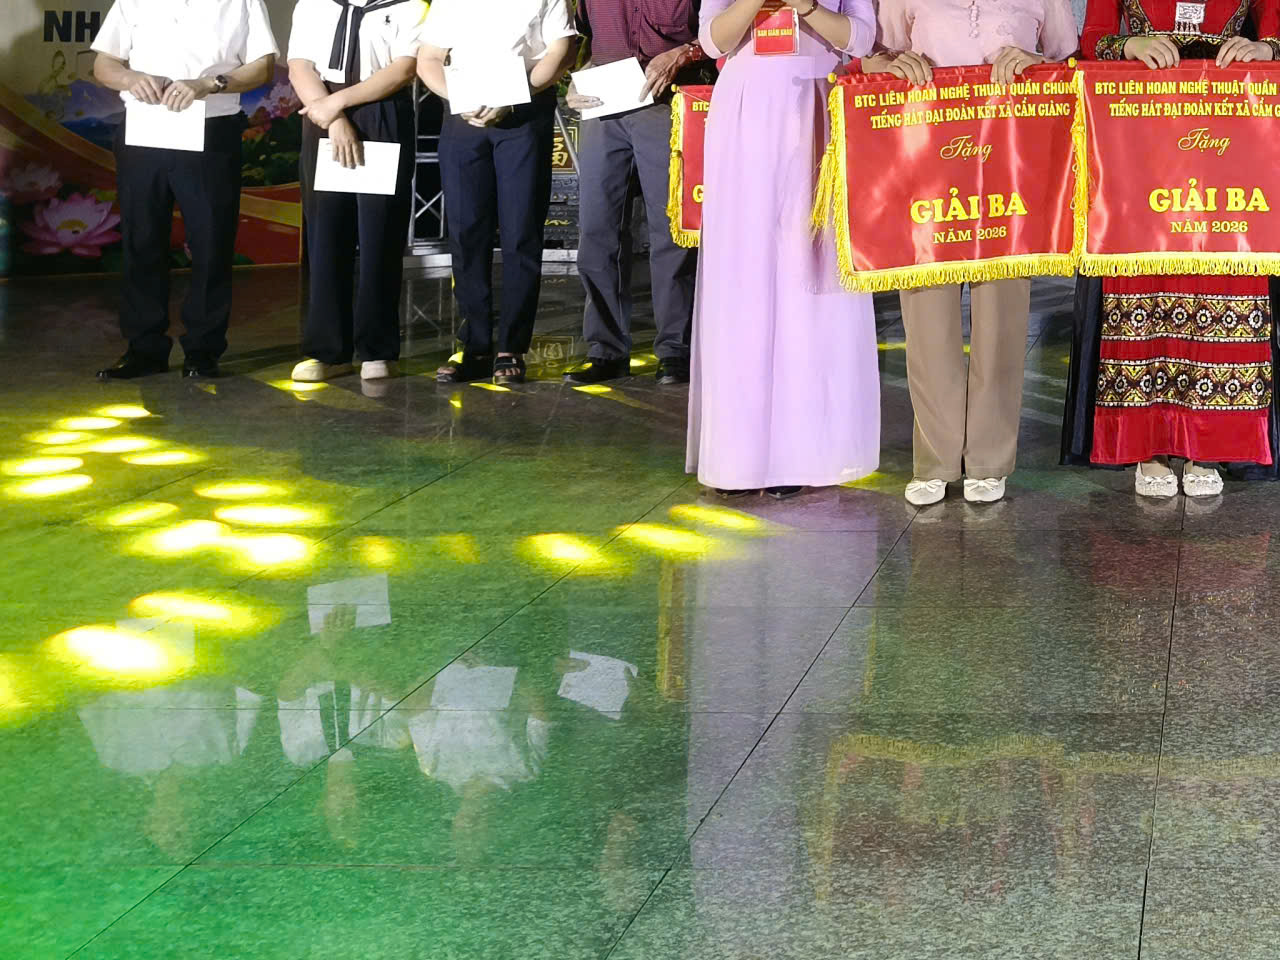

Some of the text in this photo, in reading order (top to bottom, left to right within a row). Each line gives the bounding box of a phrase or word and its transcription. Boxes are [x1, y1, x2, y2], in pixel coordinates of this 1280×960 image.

[44, 10, 101, 43] NH
[854, 95, 876, 108] BTC
[879, 90, 904, 107] LIÊN
[908, 88, 937, 104] HOAN
[940, 83, 970, 101] NGHỆ
[1010, 79, 1040, 96] QUẦN
[1043, 80, 1077, 95] CHÚN
[1095, 82, 1116, 95] BTC
[1119, 80, 1143, 95] LIÊN
[1147, 82, 1176, 95] HOAN
[1179, 79, 1208, 97] NGHỆ
[1212, 80, 1245, 97] THUẬT
[1248, 79, 1277, 96] QUẦN
[871, 97, 1070, 129] TIẾNG HÁT ĐẠI ĐOÀN KẾT XÃ CẨM GIÀNG
[1110, 98, 1139, 117] TIẾNG
[1142, 99, 1162, 117] HÁT
[1164, 103, 1182, 119] ĐẠI
[1184, 99, 1211, 116] ĐOÀN
[1214, 98, 1234, 116] KẾT
[1236, 100, 1250, 117] XÃ
[1252, 97, 1272, 118] CẨM
[940, 135, 993, 162] Tặng
[1178, 128, 1230, 156] Tặng
[910, 188, 1028, 224] GIẢI BA
[1149, 178, 1270, 212] GIẢI BA
[933, 226, 1007, 244] NĂM 2026
[1170, 218, 1248, 233] NĂM 2026
